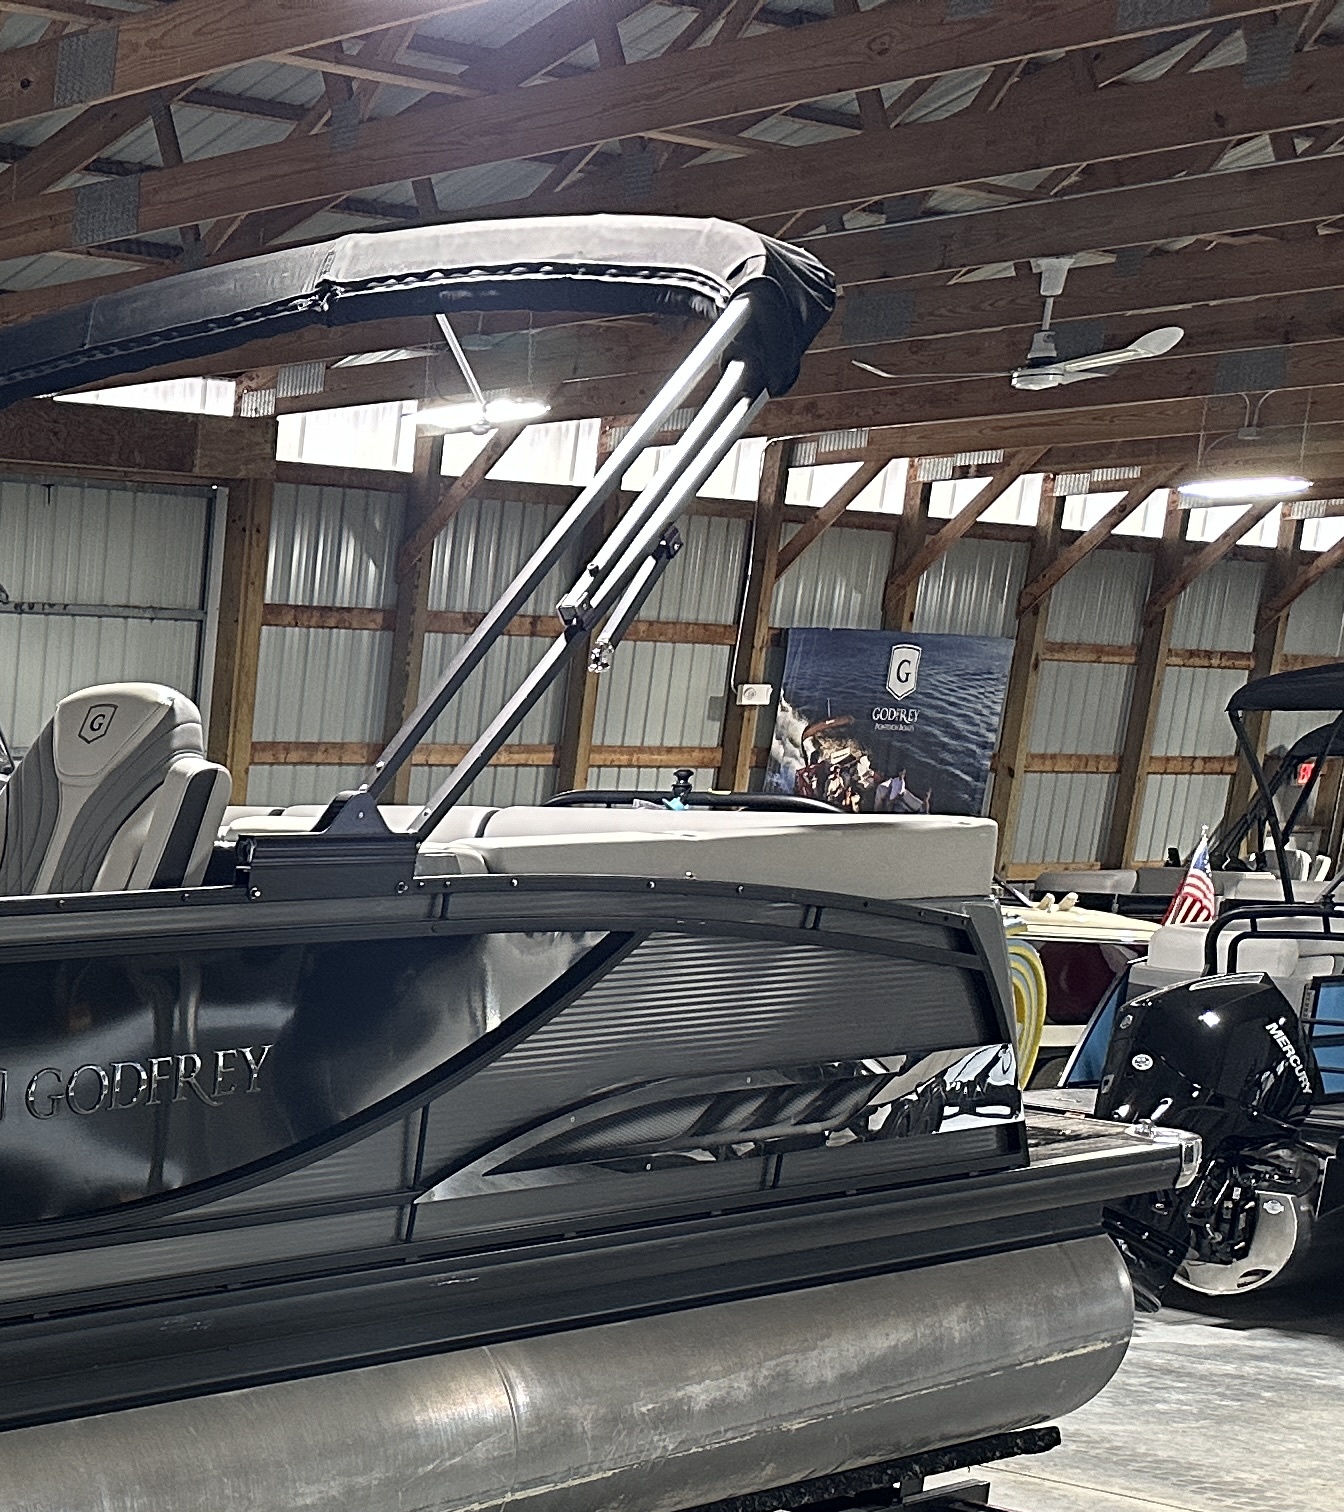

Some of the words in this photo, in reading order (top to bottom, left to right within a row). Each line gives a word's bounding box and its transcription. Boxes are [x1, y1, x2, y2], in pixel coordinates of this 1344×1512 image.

[896, 659, 912, 683] G
[25, 1044, 274, 1120] GODFREY
[1265, 1022, 1313, 1094] MERCURY
